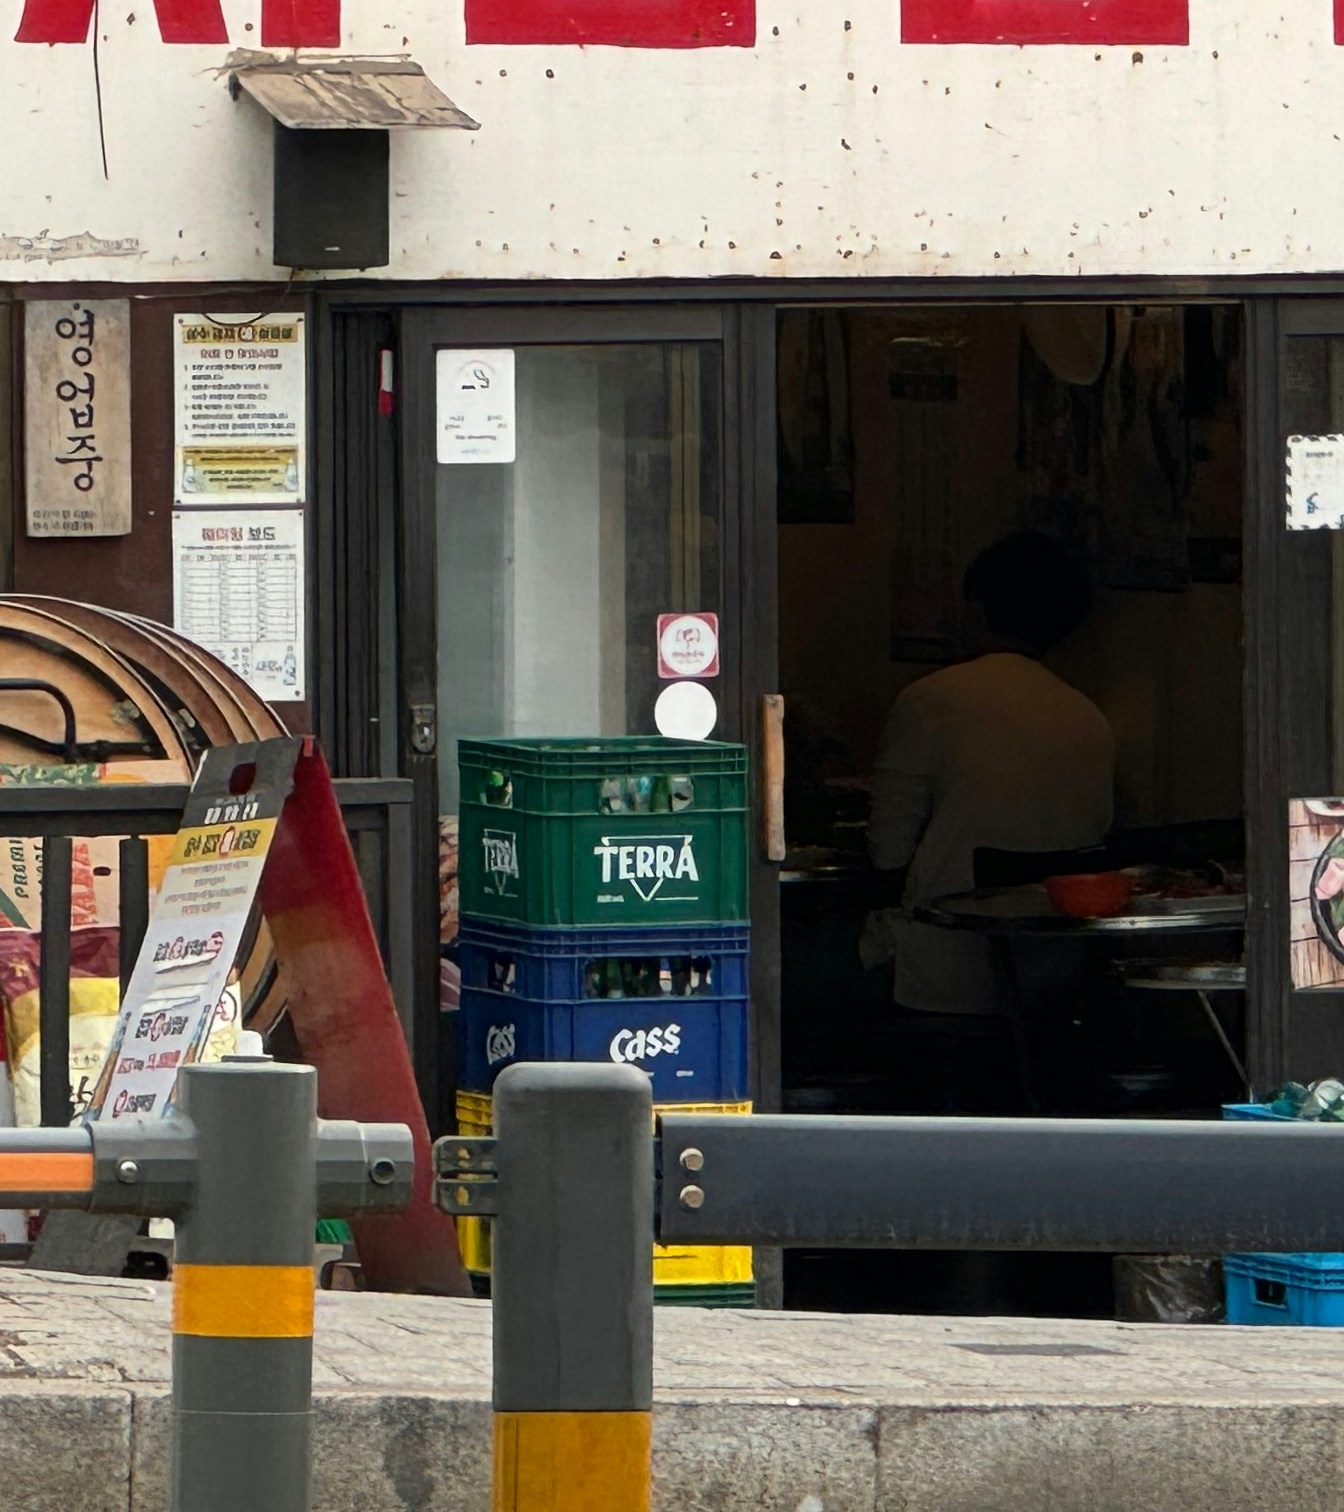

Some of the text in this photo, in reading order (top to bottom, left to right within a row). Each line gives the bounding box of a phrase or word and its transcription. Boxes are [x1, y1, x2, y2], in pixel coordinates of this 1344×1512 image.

[55, 308, 104, 493] 영업중
[594, 843, 700, 883] TERRA
[610, 1024, 682, 1064] Cass
